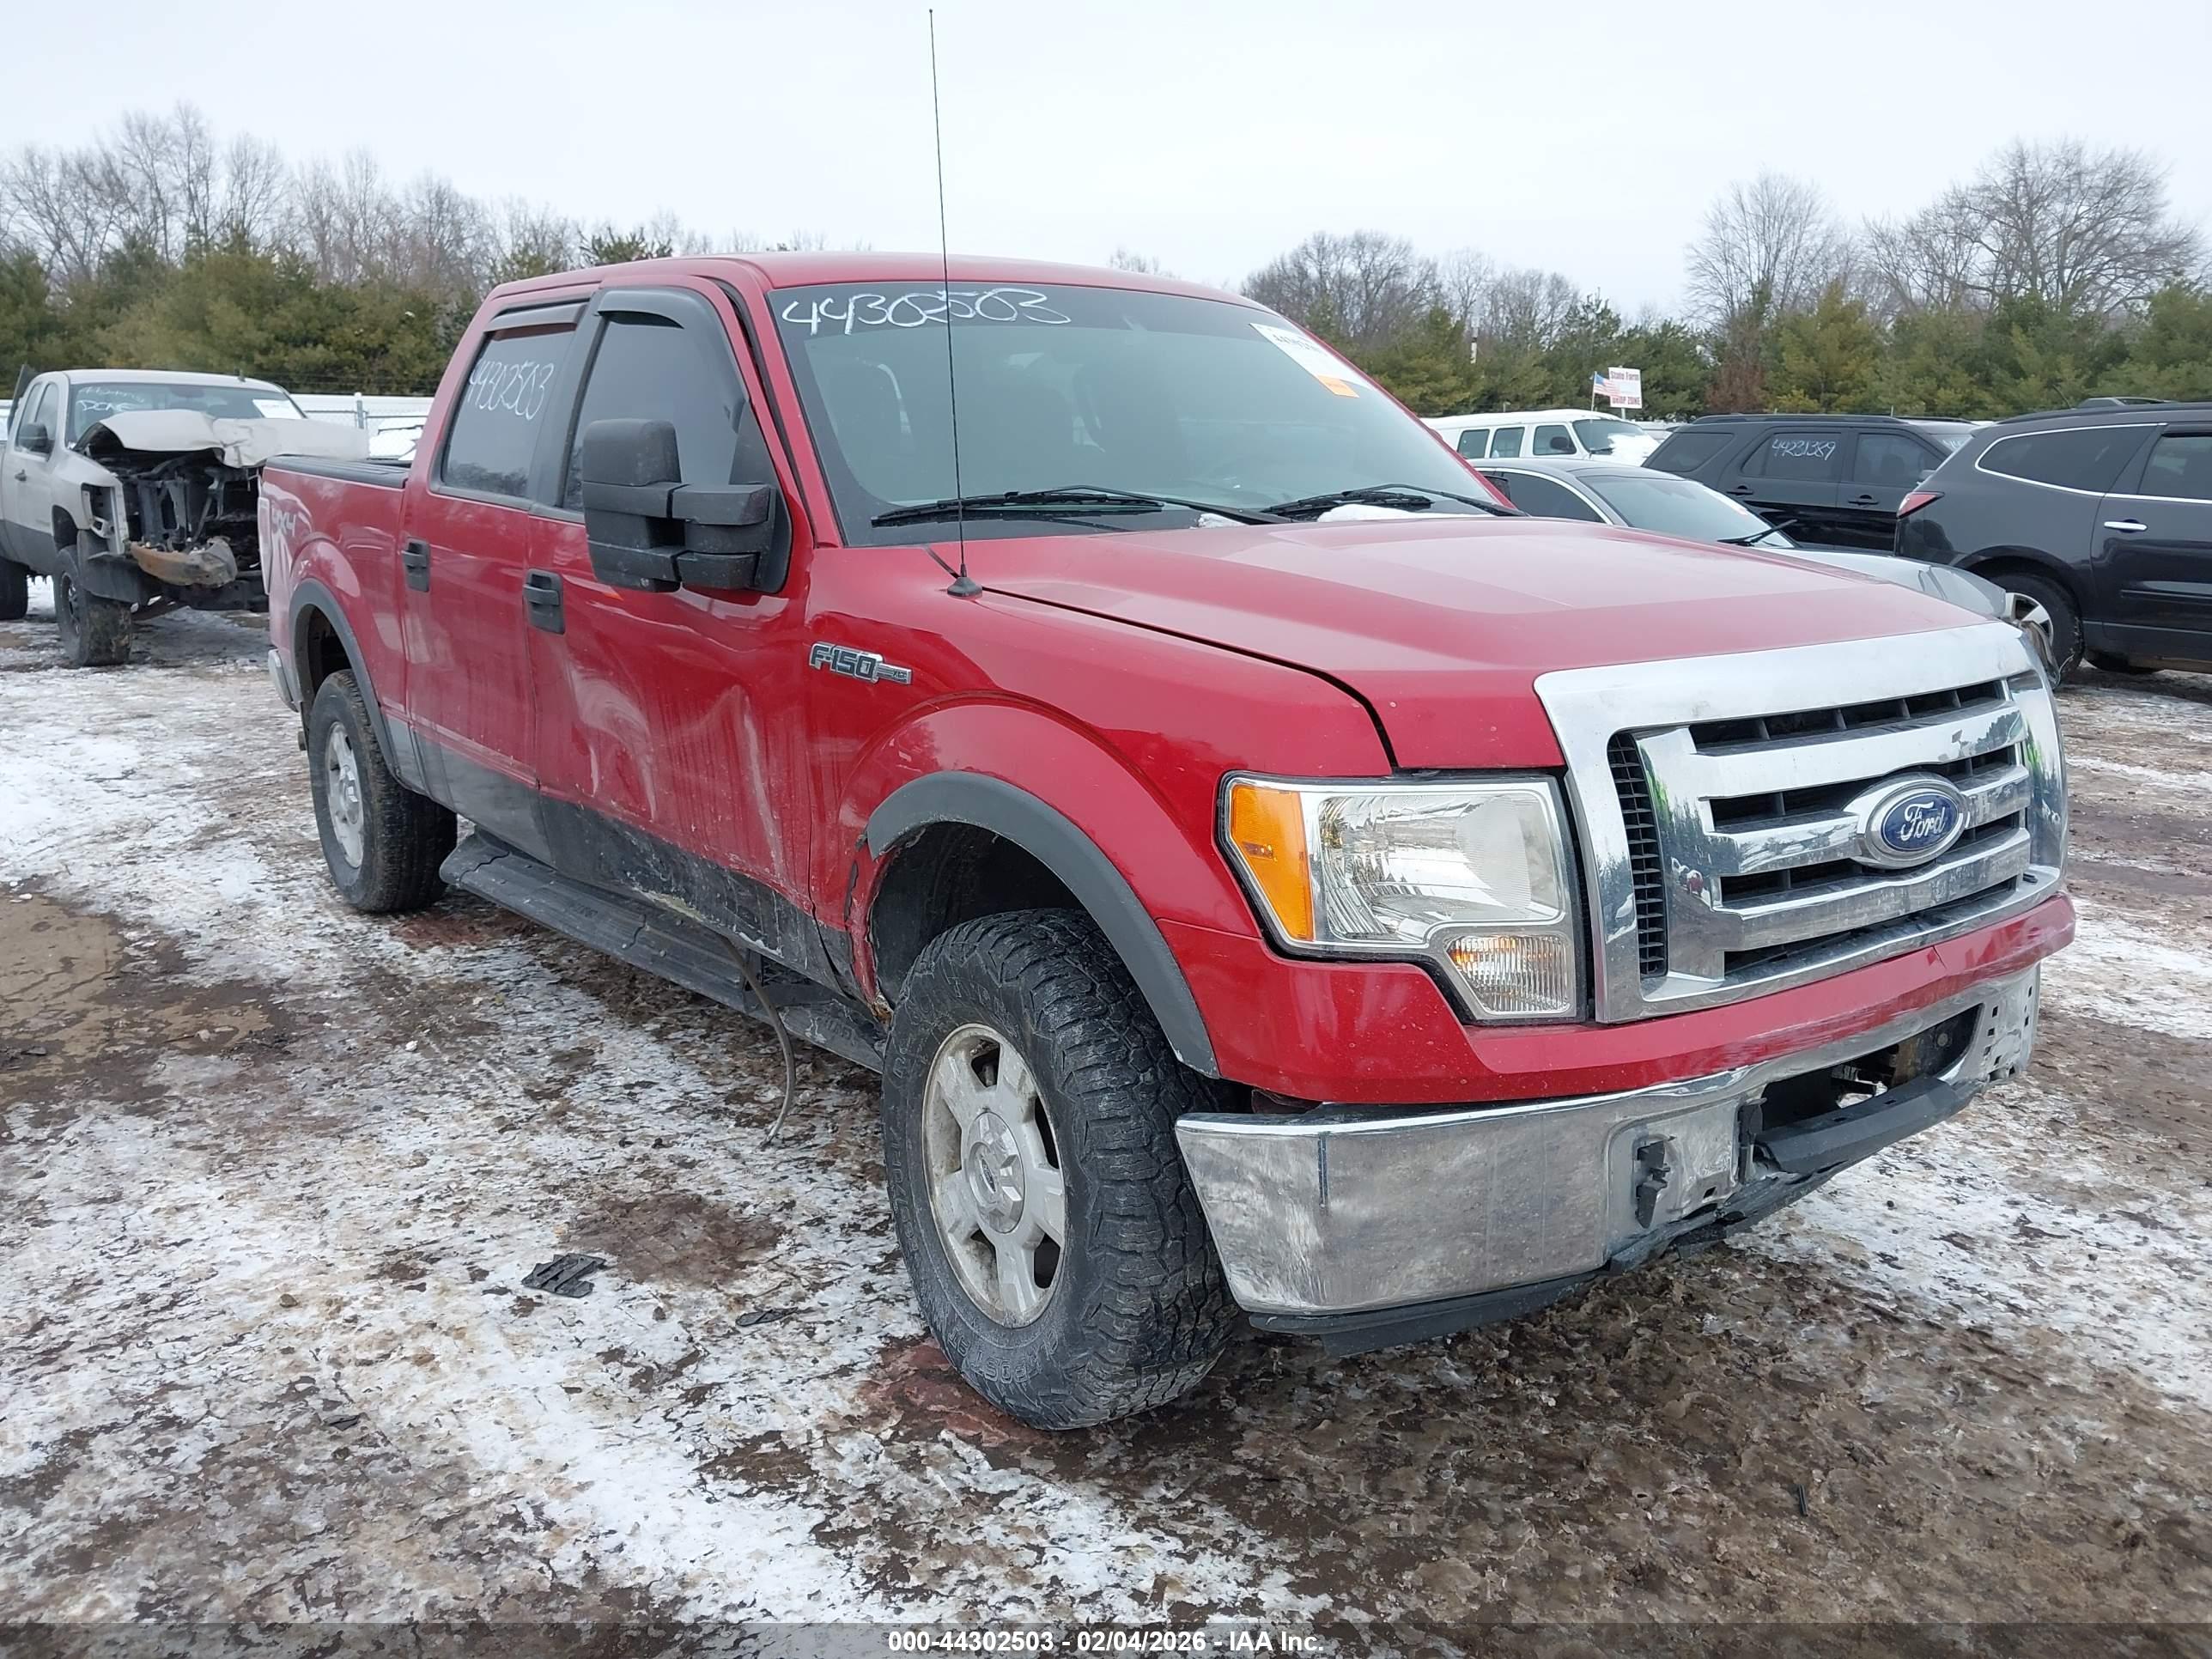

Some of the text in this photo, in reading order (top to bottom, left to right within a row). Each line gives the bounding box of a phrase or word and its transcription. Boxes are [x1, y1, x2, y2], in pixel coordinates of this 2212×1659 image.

[782, 288, 1071, 336] 44302503
[467, 359, 555, 421] 44302503
[1899, 801, 1946, 842] Ford
